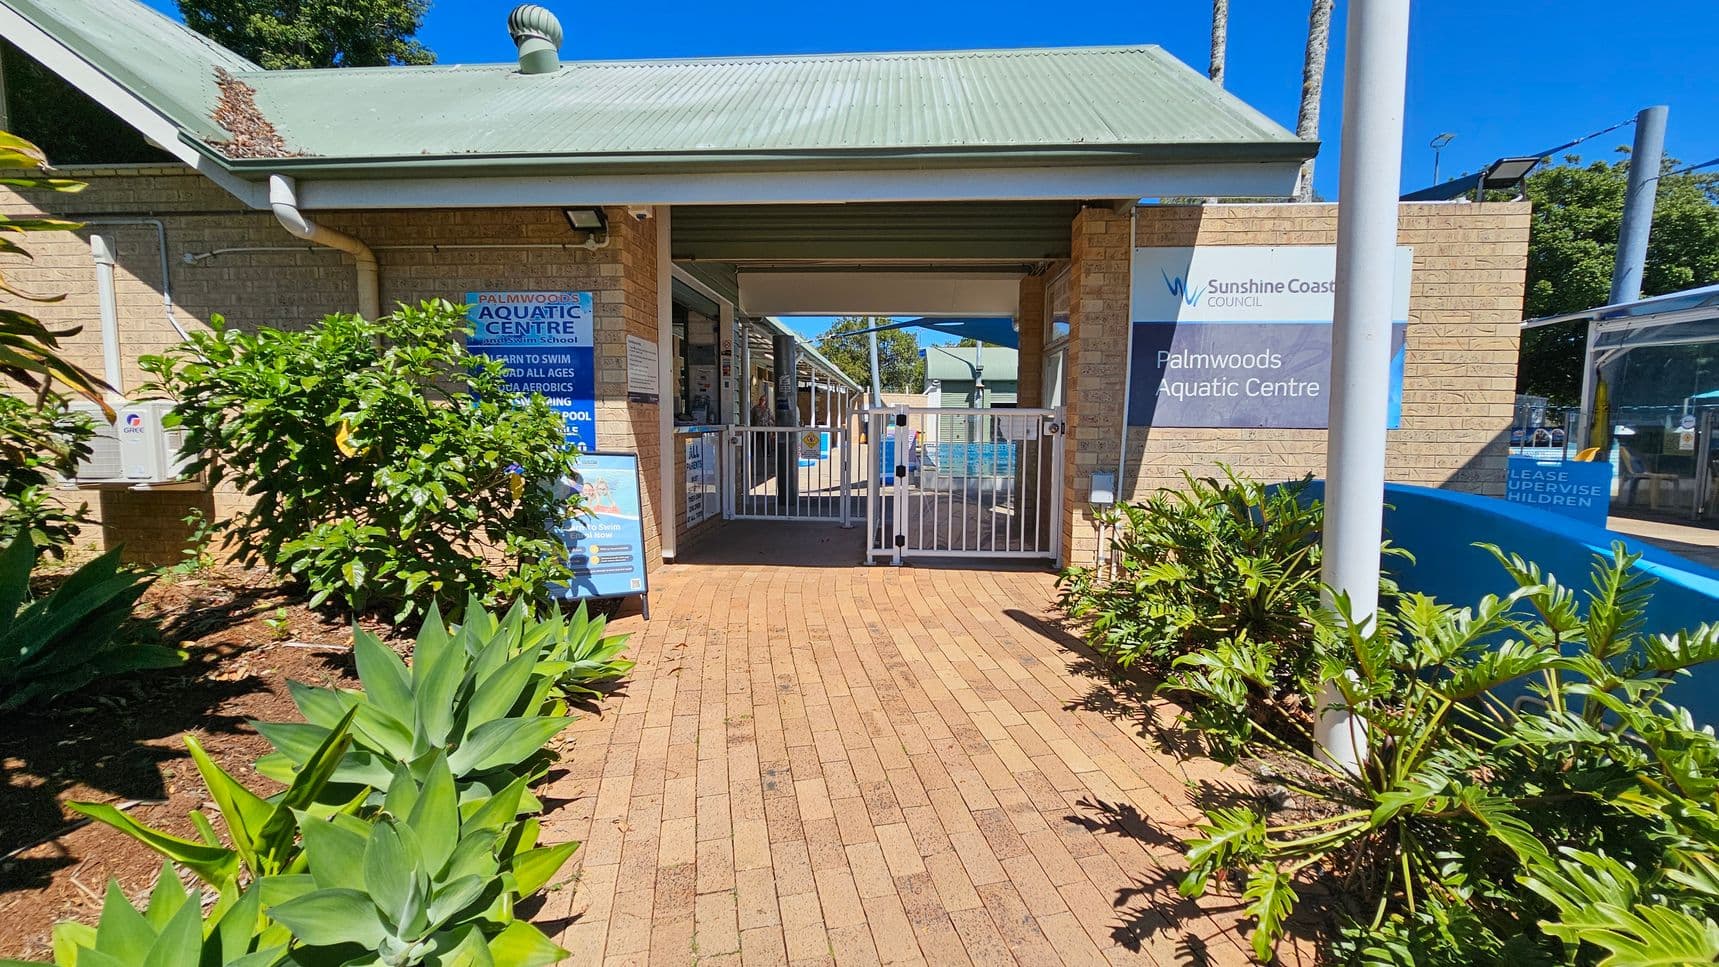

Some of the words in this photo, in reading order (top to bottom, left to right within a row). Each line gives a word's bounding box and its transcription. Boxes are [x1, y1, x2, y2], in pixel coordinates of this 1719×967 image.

[1208, 279, 1285, 294] Sunshine
[1287, 278, 1336, 294] Coast
[479, 294, 580, 304] PALMWOODS
[1207, 296, 1263, 308] COUNCIL
[479, 305, 581, 320] AQUATIC
[485, 321, 575, 335] CENTRE
[483, 337, 506, 345] and
[540, 336, 578, 344] School
[524, 354, 540, 364] TO
[541, 354, 571, 364] SWIM
[1157, 348, 1282, 369] Palmwoods
[526, 368, 547, 378] ALL
[550, 368, 575, 378] AGES
[496, 382, 521, 392] QUA
[524, 382, 574, 392] AEROBICS
[1156, 377, 1239, 402] Aquatic
[1246, 377, 1320, 397] Centre
[562, 411, 592, 422] POOL
[1507, 469, 1569, 482] LEASE
[1508, 480, 1602, 497] UPERVISE
[1508, 491, 1592, 507] HILDREN
[598, 523, 621, 532] Swim
